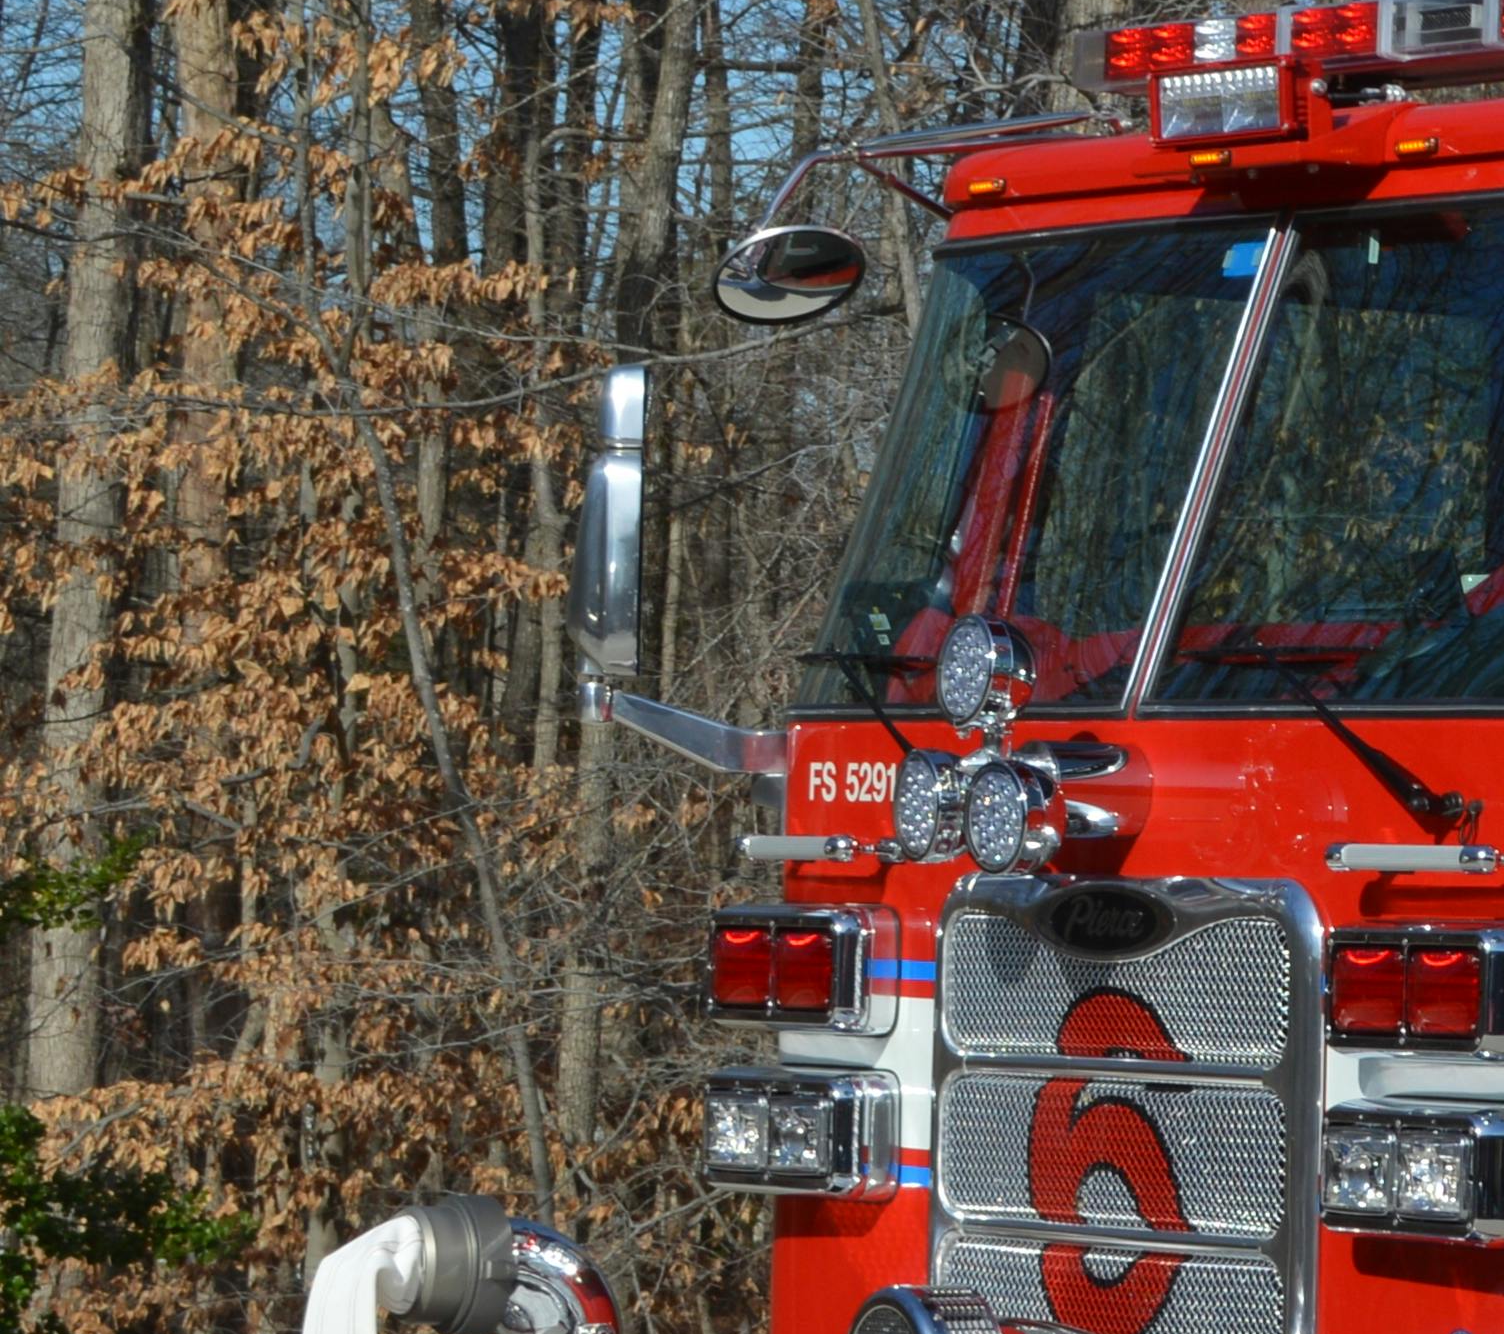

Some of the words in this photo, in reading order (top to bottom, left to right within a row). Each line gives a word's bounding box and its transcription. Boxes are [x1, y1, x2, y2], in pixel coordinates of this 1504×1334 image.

[809, 761, 837, 802] FS
[845, 761, 897, 802] 5291
[1064, 894, 1145, 941] Pierce
